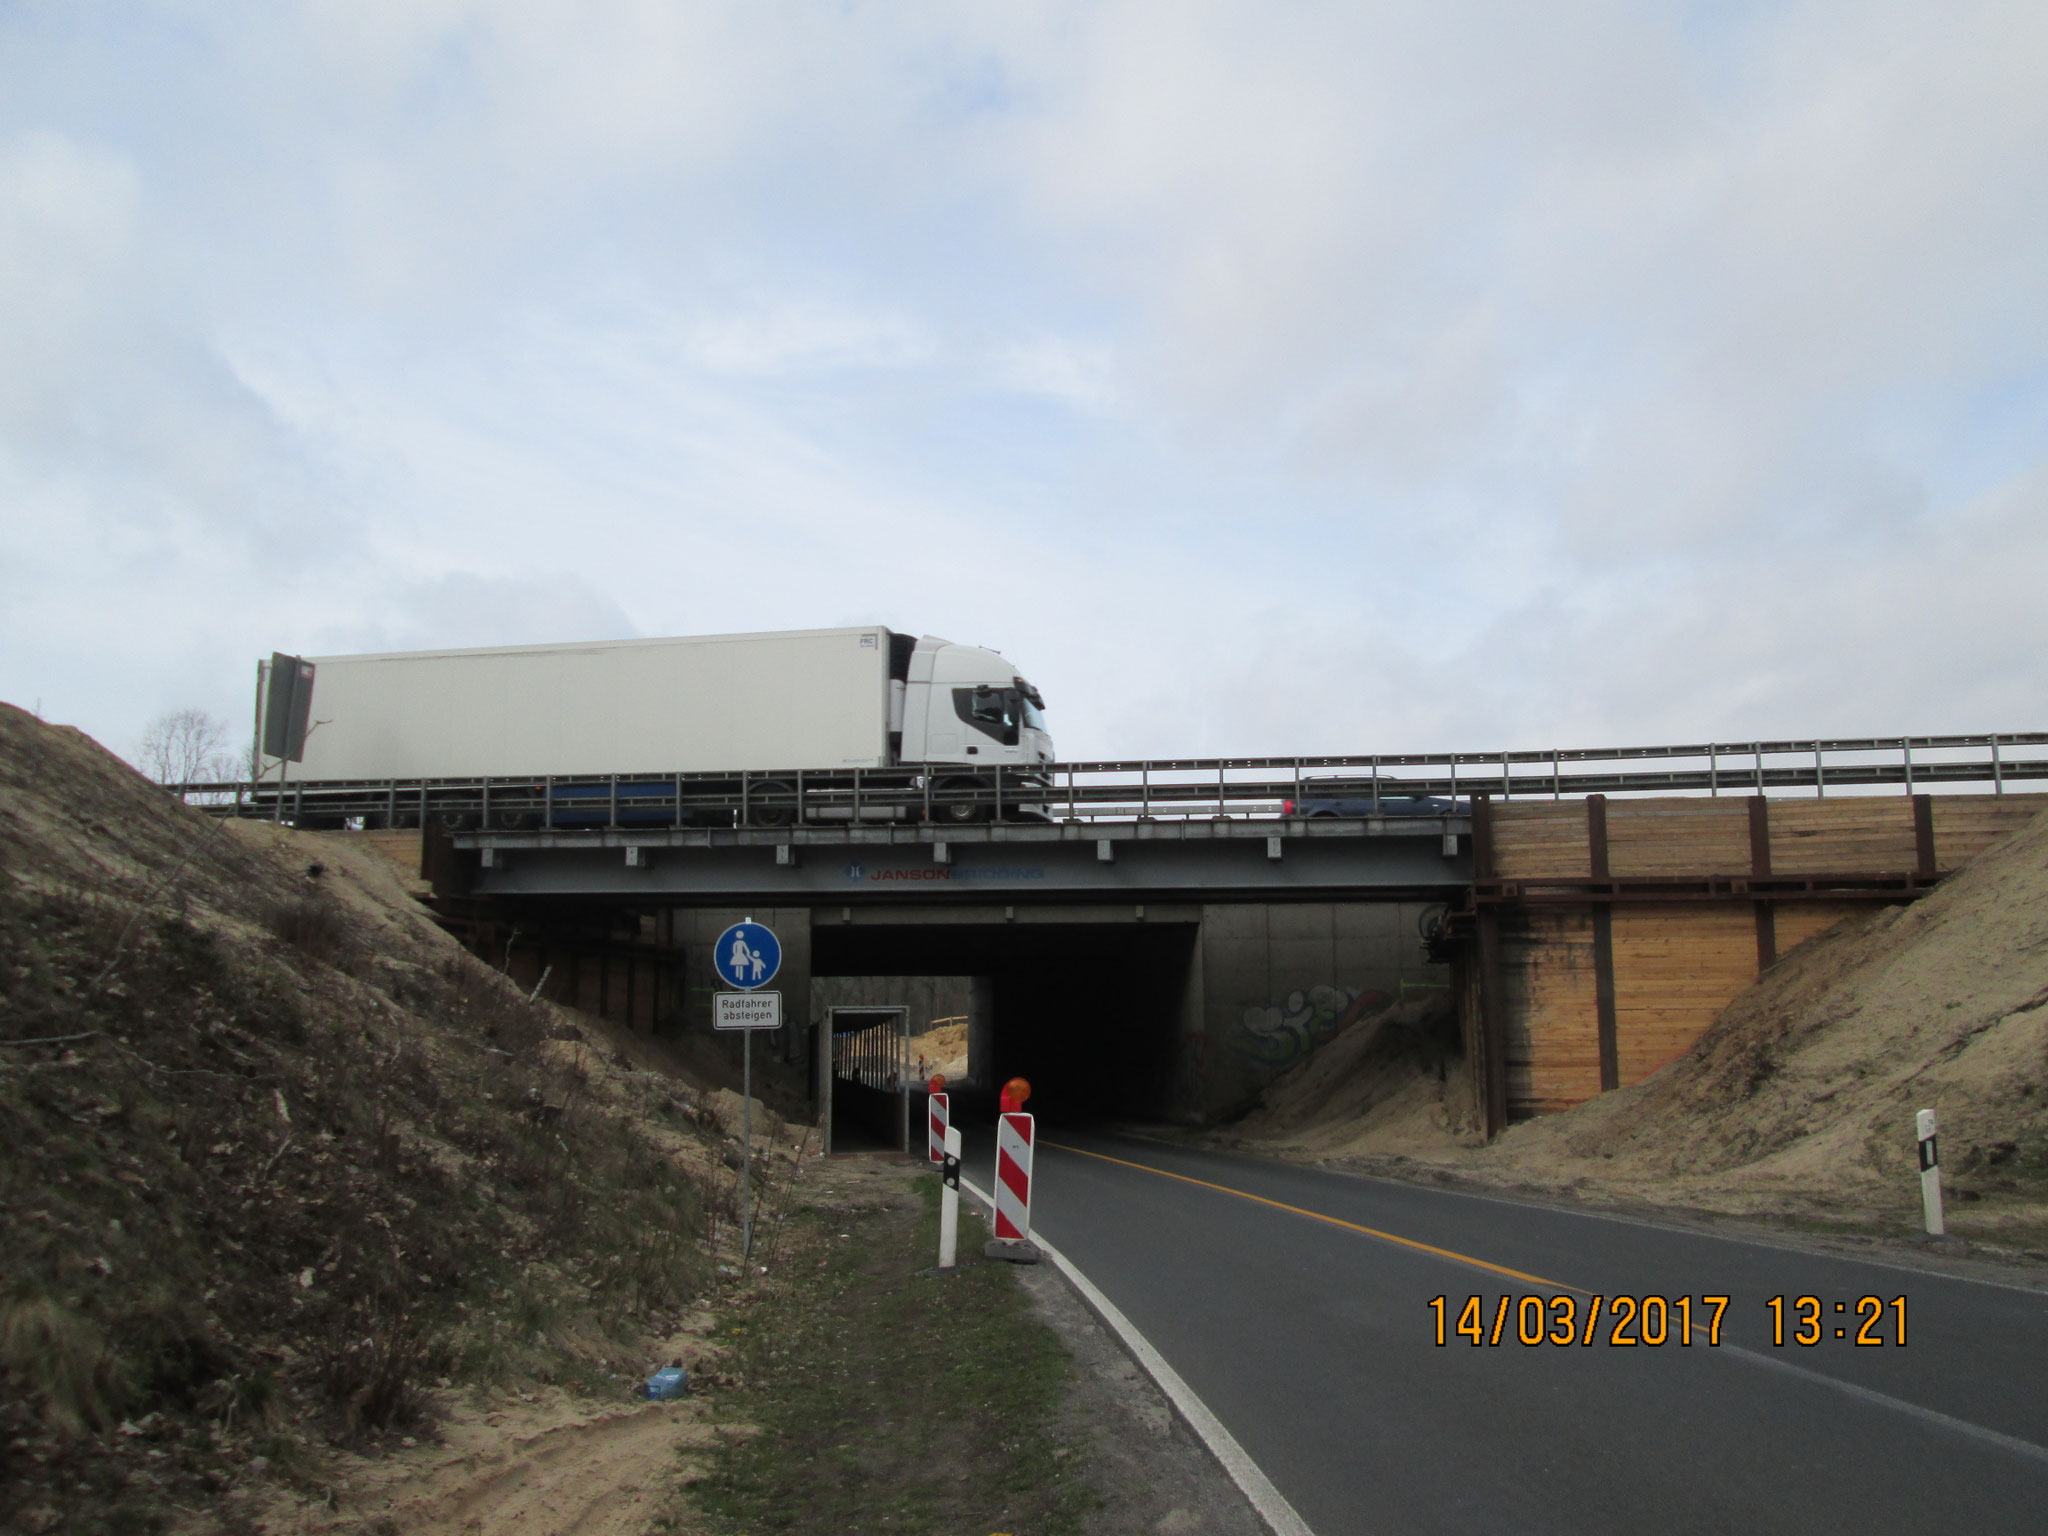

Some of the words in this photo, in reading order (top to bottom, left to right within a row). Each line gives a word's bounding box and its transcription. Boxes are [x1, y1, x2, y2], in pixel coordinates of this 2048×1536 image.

[871, 869, 950, 881] JANSON
[722, 999, 772, 1009] Radfahrer
[723, 1011, 772, 1021] absteigen
